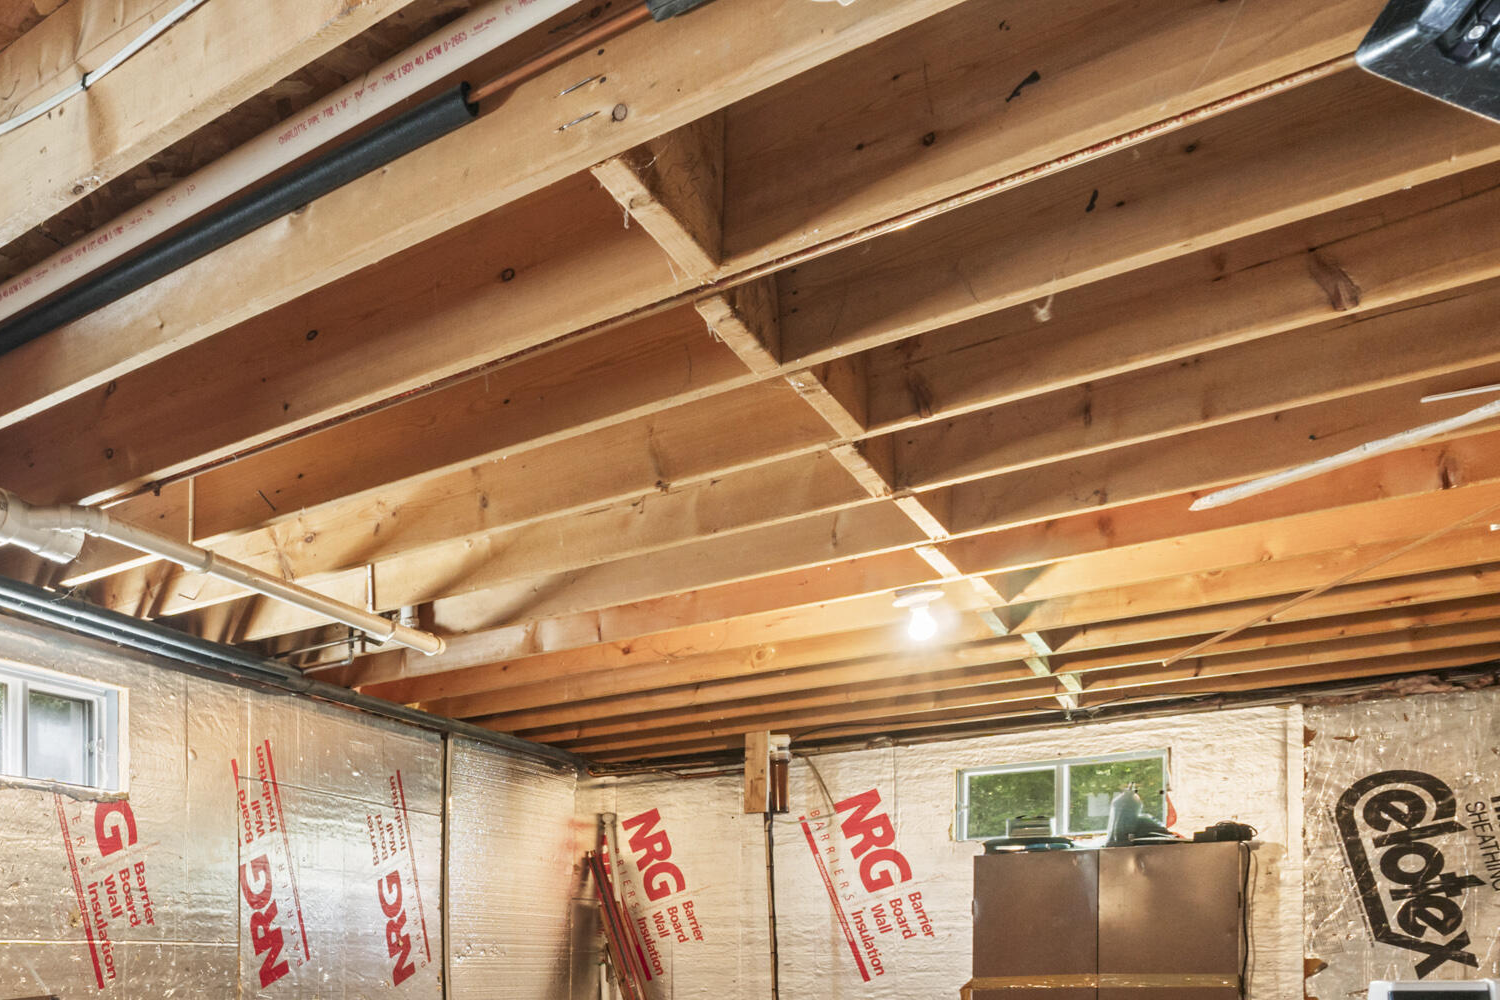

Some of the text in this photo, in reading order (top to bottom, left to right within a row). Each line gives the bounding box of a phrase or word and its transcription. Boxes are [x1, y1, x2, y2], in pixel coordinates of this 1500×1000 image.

[250, 799, 266, 838] Wall
[256, 746, 277, 833] Insulation
[385, 823, 397, 856] Wall
[622, 808, 686, 902] NRG
[810, 809, 854, 902] BARRIERS
[833, 788, 912, 893] NRG
[103, 874, 124, 919] Wall
[119, 867, 141, 928] Board
[134, 861, 155, 926] Barrier
[240, 854, 289, 989] NRG
[682, 900, 704, 942] Barrier
[871, 903, 893, 934] Wall
[889, 898, 917, 940] Board
[908, 891, 936, 938] Barrier
[87, 881, 116, 980] Insulation
[378, 869, 416, 987] NRG
[637, 916, 664, 976] Insulation
[652, 911, 671, 938] Wall
[667, 906, 689, 944] Board
[851, 910, 885, 976] Insulation
